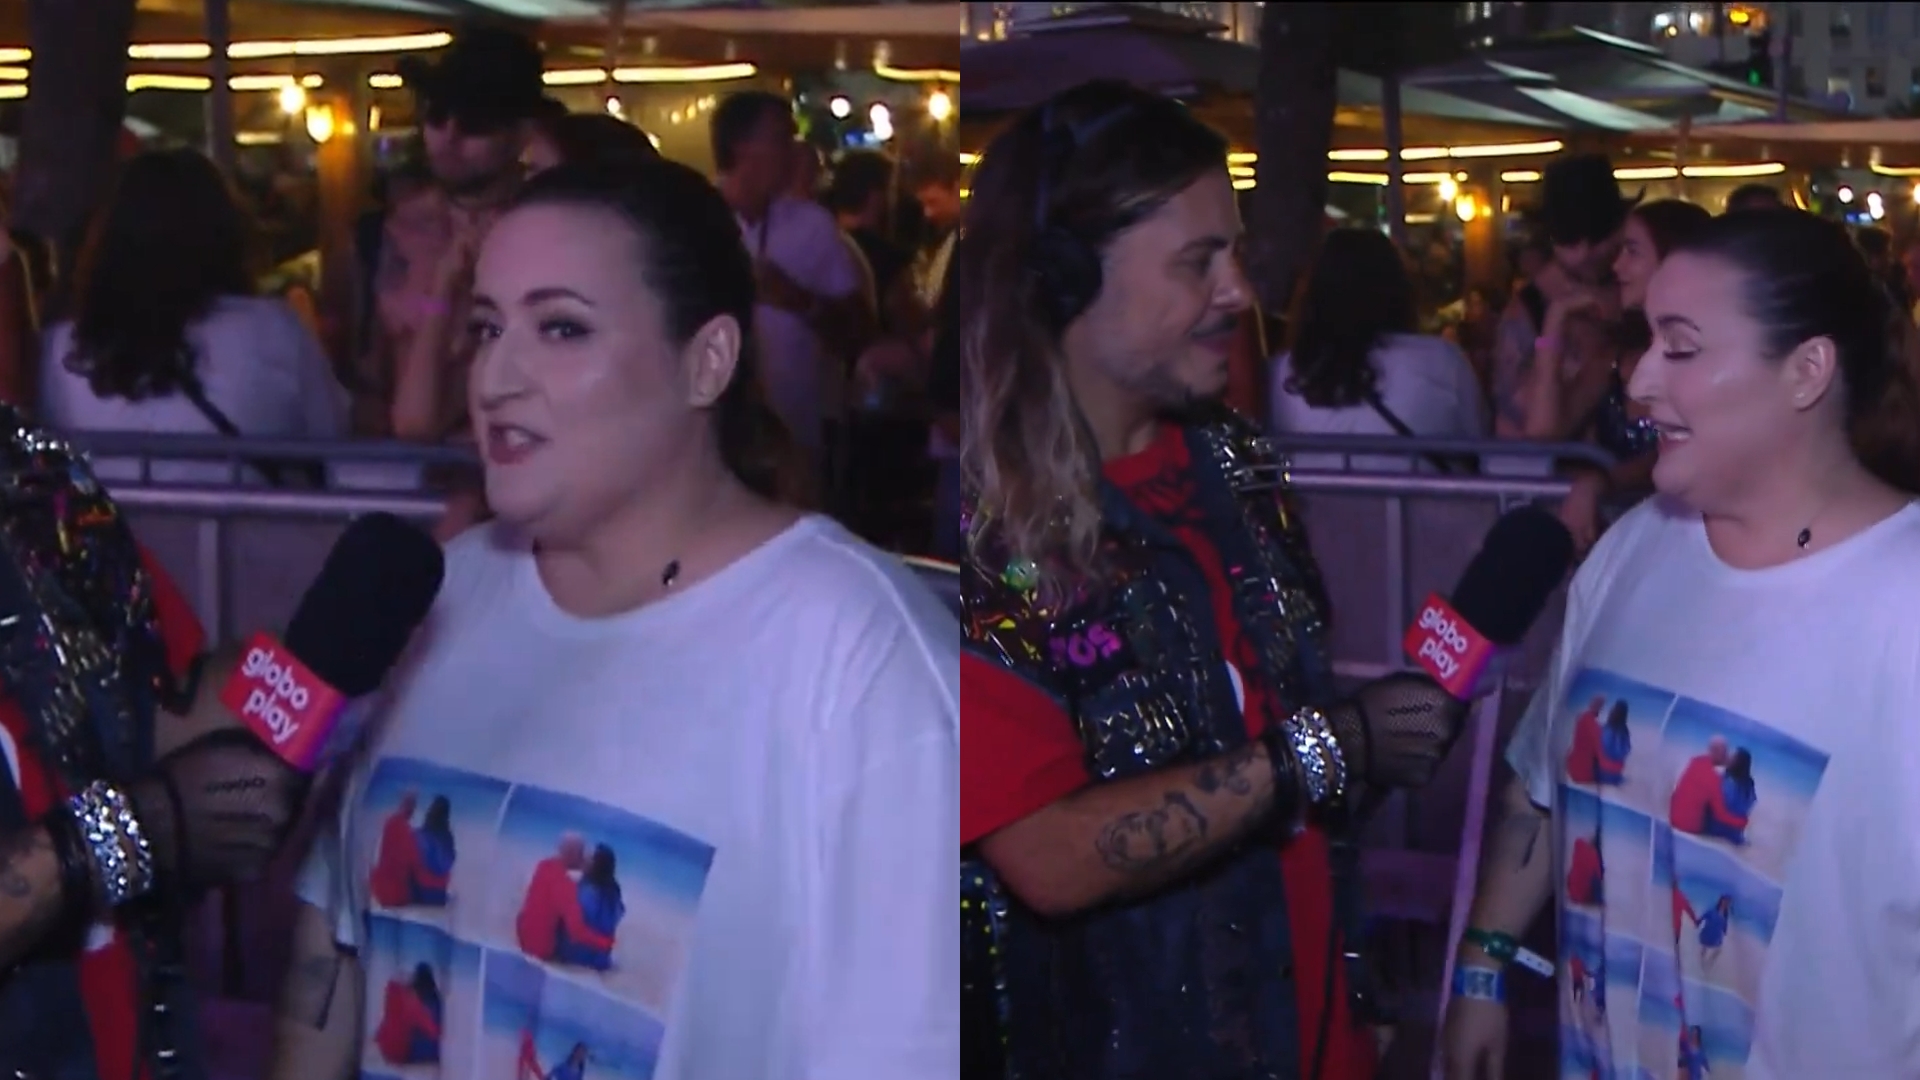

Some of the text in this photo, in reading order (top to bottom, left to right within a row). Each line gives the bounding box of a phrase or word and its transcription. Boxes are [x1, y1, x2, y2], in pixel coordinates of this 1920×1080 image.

[1418, 606, 1467, 653] globo
[241, 647, 308, 710] globo
[1418, 637, 1460, 680] play
[242, 689, 299, 744] play
